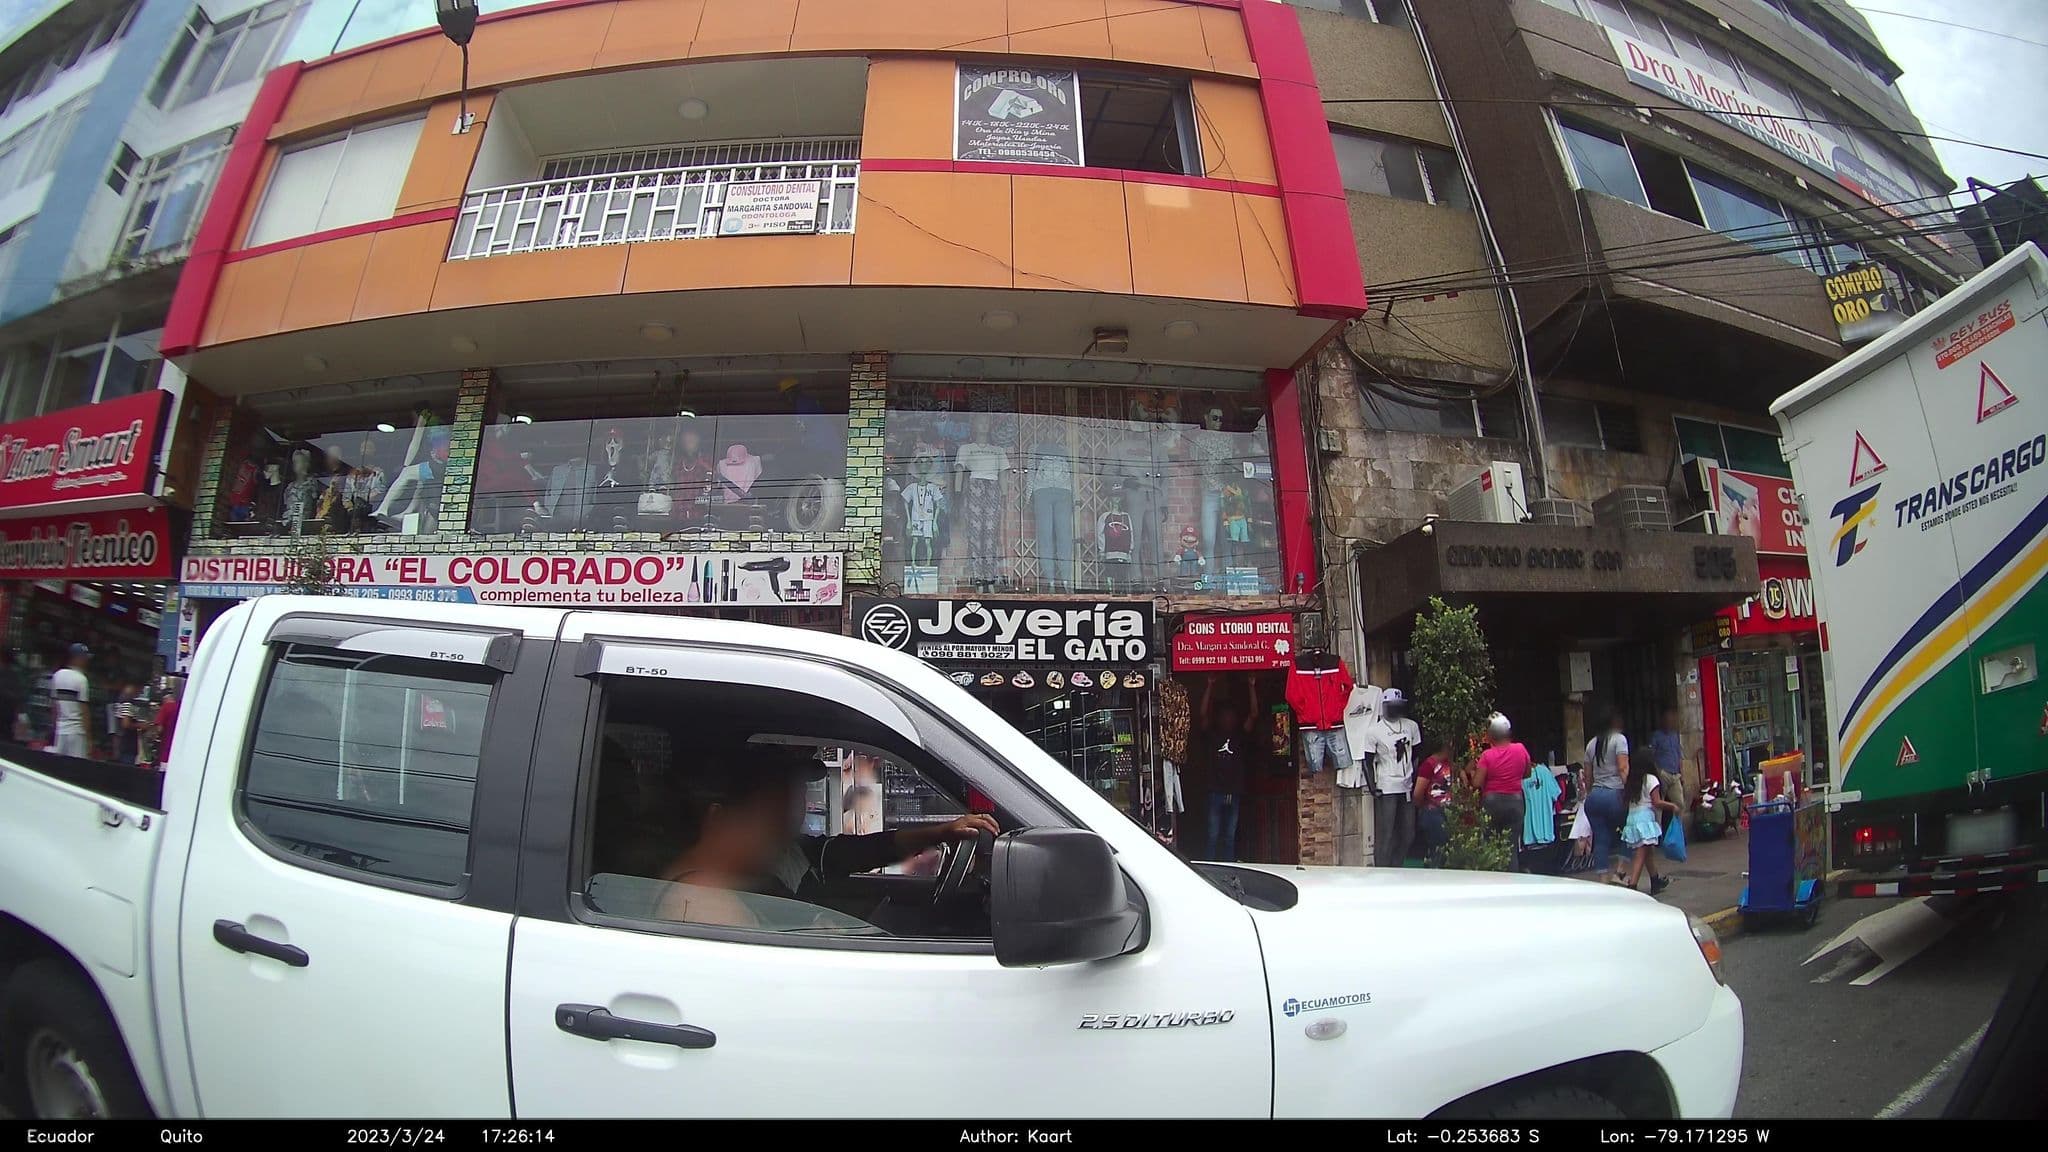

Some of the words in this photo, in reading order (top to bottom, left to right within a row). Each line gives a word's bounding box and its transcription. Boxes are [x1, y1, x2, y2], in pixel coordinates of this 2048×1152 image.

[964, 70, 1032, 101] COMPRO
[1036, 75, 1066, 105] ORO
[1625, 39, 1686, 90] Dra.
[1684, 67, 1755, 123] María
[1757, 105, 1809, 157] Chico
[1810, 132, 1831, 166] N.
[730, 184, 783, 196] CONSULTORIO
[785, 183, 816, 194] DENTAL
[727, 204, 771, 212] MARGARITA
[772, 202, 813, 211] SANDOVAL
[1825, 266, 1883, 301] COMPRO
[1832, 298, 1871, 326] ORO
[1950, 321, 1975, 343] REY
[56, 419, 143, 475] Smart
[1894, 433, 2047, 528] TRANSCARGO
[1921, 514, 1944, 532] ESTAMOS
[1962, 499, 1978, 514] USTED
[388, 589, 414, 600] 0993
[415, 589, 435, 601] 603
[480, 587, 594, 604] complementa
[596, 588, 617, 603] tu
[620, 588, 684, 603] belleza
[918, 600, 1145, 644] Joyería
[1256, 622, 1291, 634] DENTAL
[980, 651, 1011, 659] 9027
[1017, 638, 1054, 661] EL
[1064, 638, 1146, 662] GATO
[1178, 641, 1193, 651] Dra.
[1229, 641, 1260, 650] Sandoval
[430, 651, 465, 662] BT-50
[625, 666, 668, 677] BT-50
[1301, 992, 1371, 1011] ECUAMOTORS
